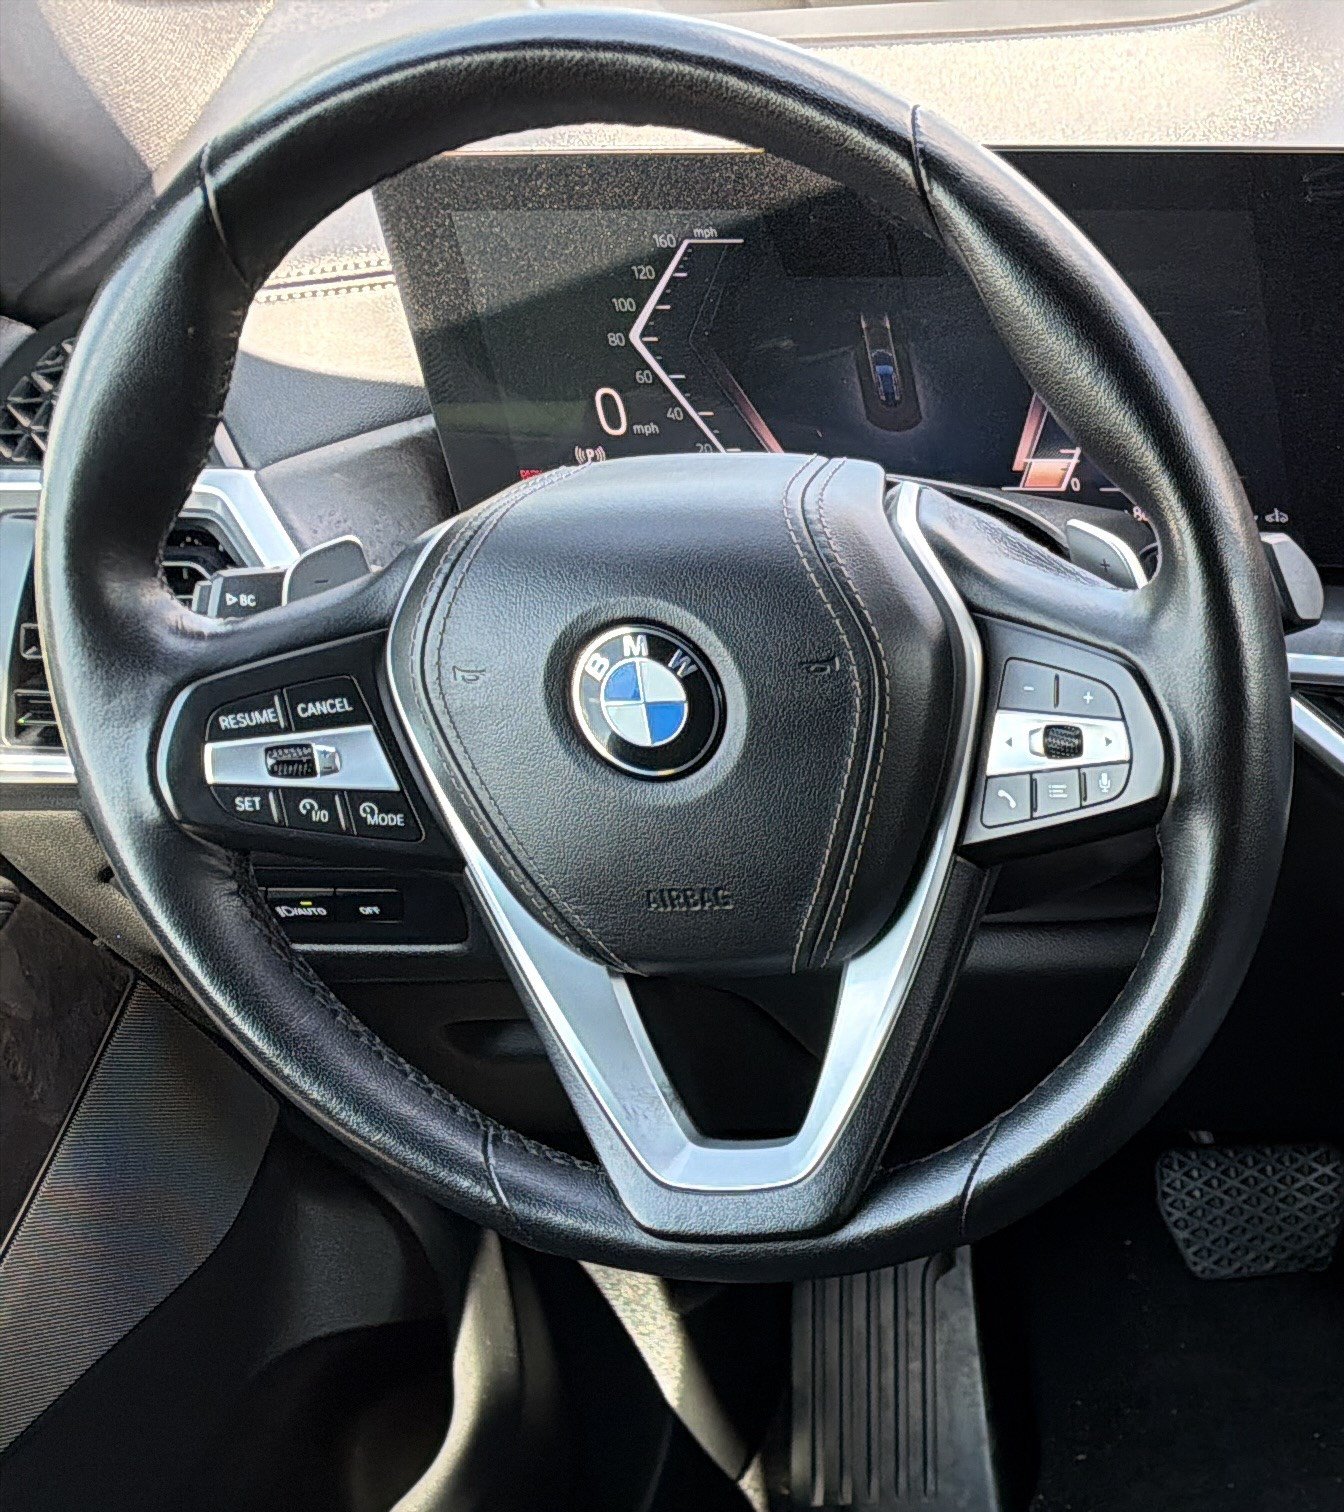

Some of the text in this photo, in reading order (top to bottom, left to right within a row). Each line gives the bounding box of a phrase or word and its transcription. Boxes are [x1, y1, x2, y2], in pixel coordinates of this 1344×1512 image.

[693, 227, 717, 239] mph
[653, 234, 676, 248] 160
[631, 265, 655, 280] 120
[611, 298, 636, 312] 100
[607, 333, 625, 347] 80
[635, 370, 653, 384] 60
[595, 387, 627, 436] 0
[667, 407, 683, 421] 40
[633, 423, 659, 435] mph
[239, 594, 257, 607] BC
[297, 698, 353, 718] CANCEL
[219, 708, 278, 730] RESUME
[235, 797, 261, 812] SET
[367, 812, 405, 827] MODE
